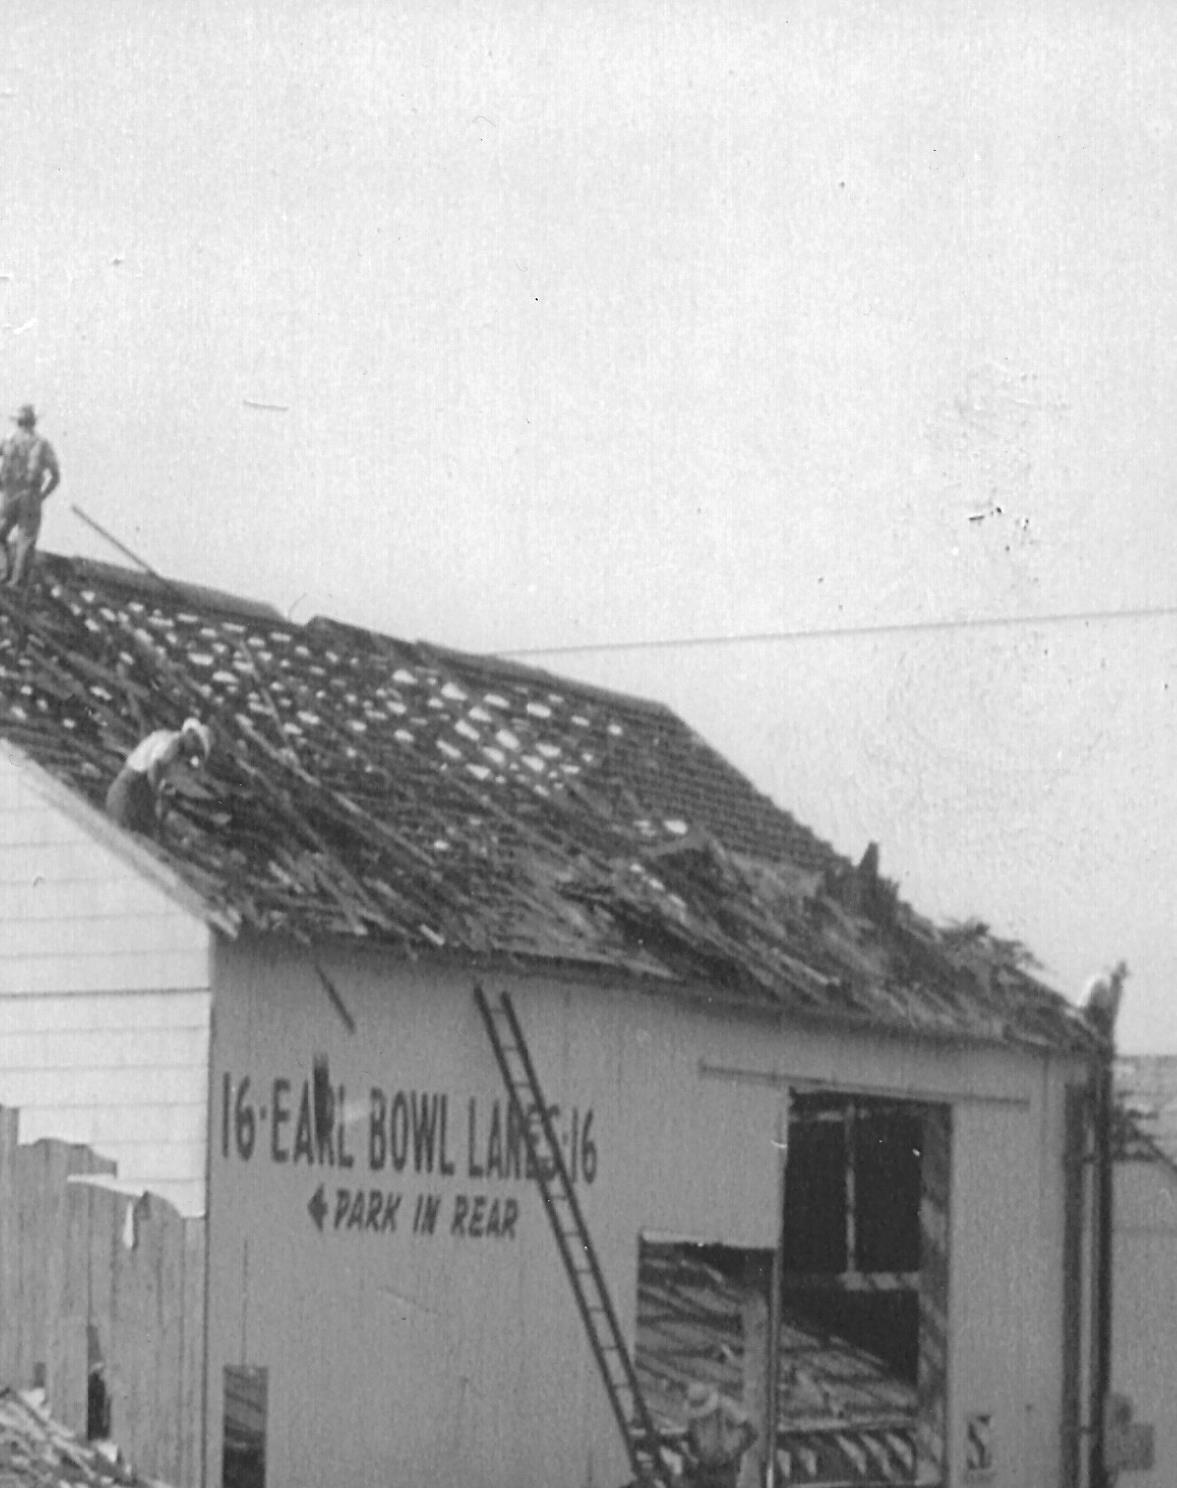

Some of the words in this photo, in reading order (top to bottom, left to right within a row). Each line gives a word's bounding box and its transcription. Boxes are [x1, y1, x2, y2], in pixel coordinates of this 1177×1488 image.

[370, 1087, 455, 1176] BOWL
[334, 1188, 402, 1232] PARK
[413, 1194, 440, 1235] IN
[451, 1195, 519, 1240] REAR
